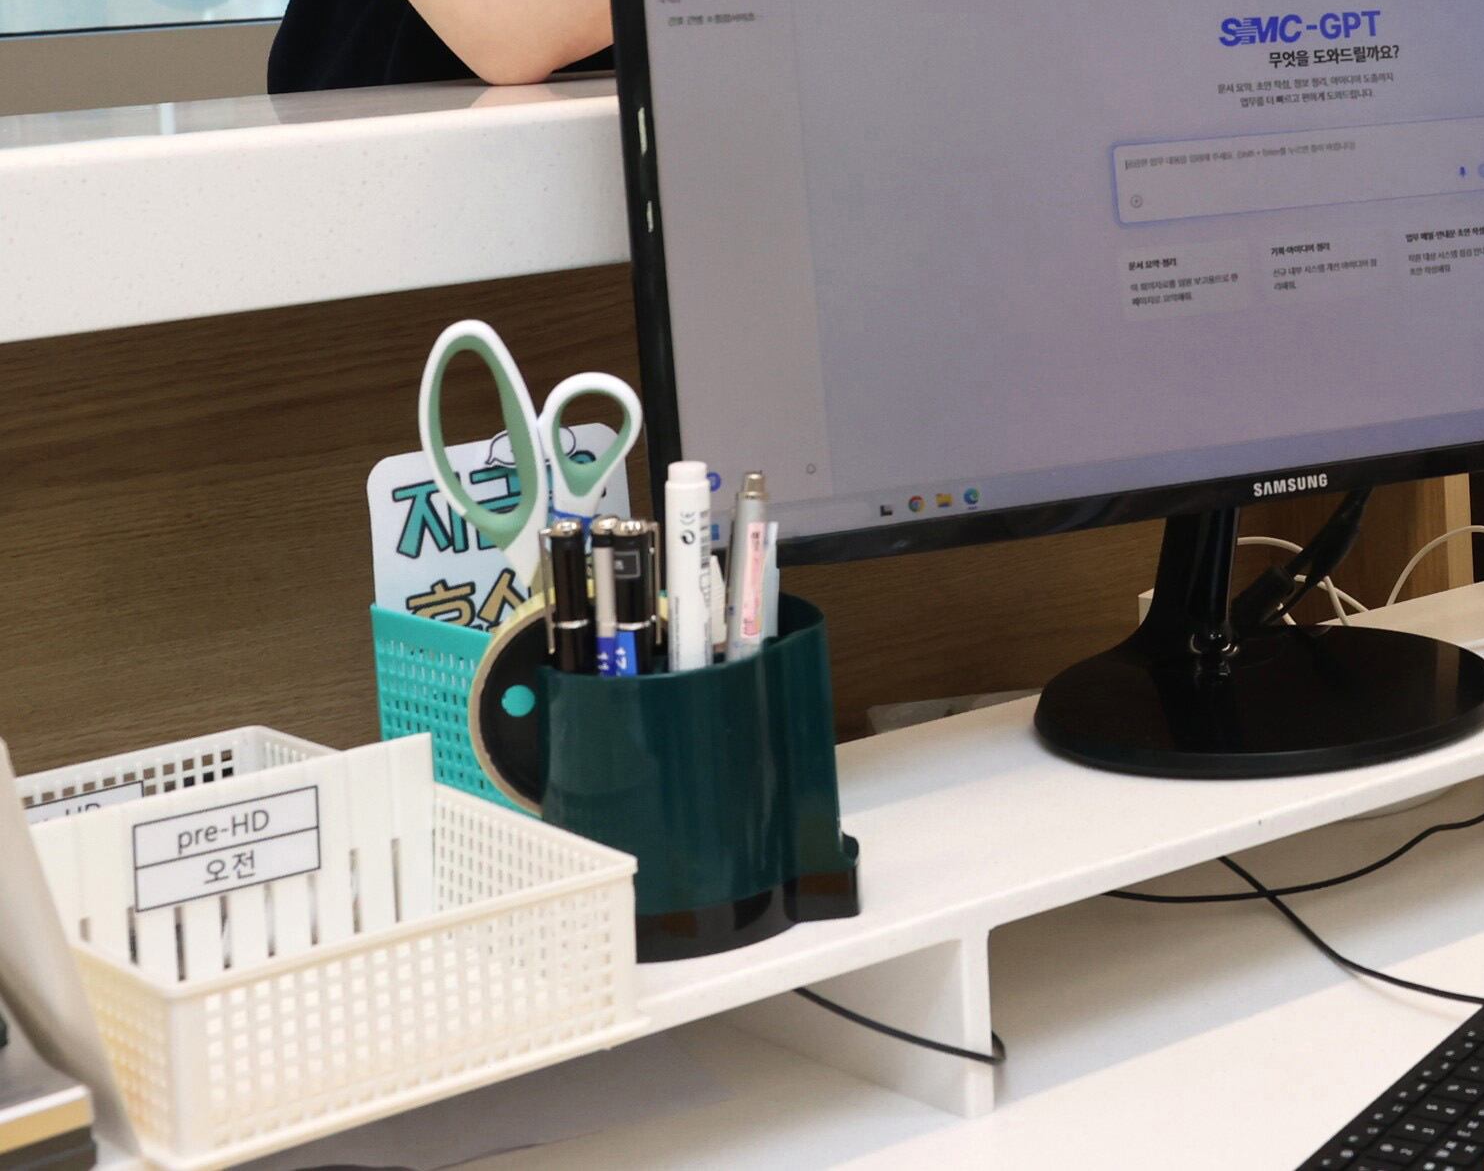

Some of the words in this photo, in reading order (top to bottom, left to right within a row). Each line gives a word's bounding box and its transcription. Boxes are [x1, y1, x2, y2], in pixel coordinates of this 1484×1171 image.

[1268, 49, 1310, 69] 무엇을
[1313, 44, 1400, 66] 도와드릴까요?
[1253, 473, 1328, 497] SAMSUNG
[177, 809, 270, 855] pre-HD
[204, 850, 256, 884] 오전
